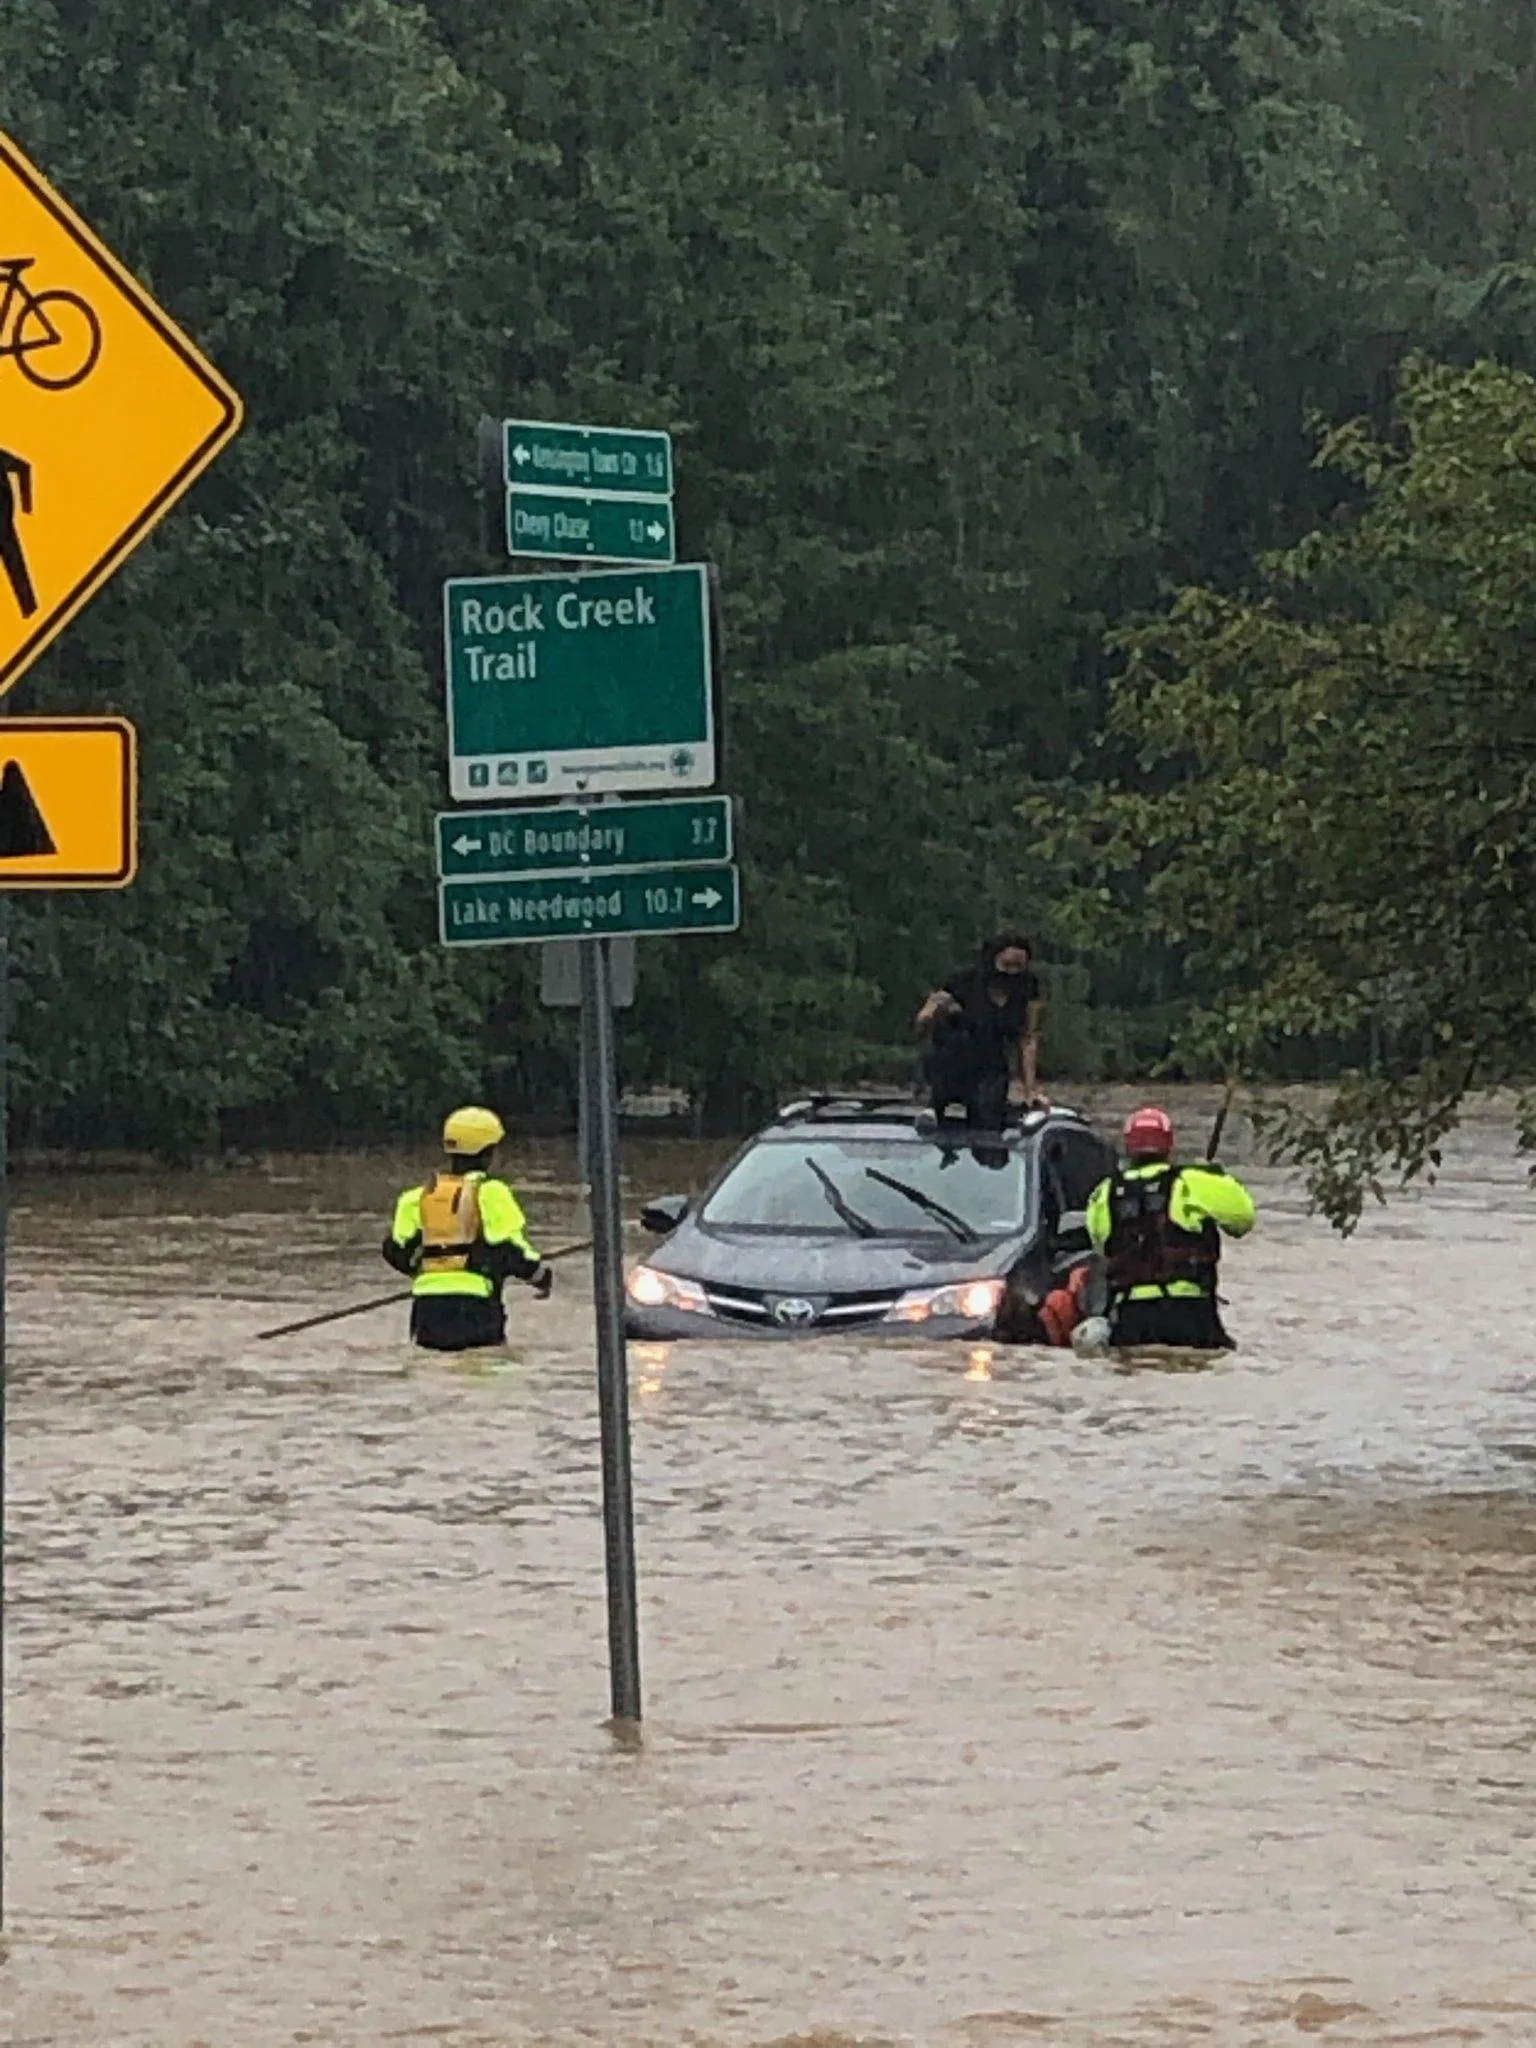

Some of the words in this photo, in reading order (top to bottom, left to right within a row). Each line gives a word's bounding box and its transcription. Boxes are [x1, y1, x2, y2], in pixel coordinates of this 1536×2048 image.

[461, 594, 545, 636] Rock
[556, 586, 656, 630] Creek
[463, 641, 537, 682] Trail
[488, 829, 515, 857] DC
[524, 823, 625, 856] Boundary
[452, 899, 501, 926] Lake
[508, 889, 621, 921] Needwood
